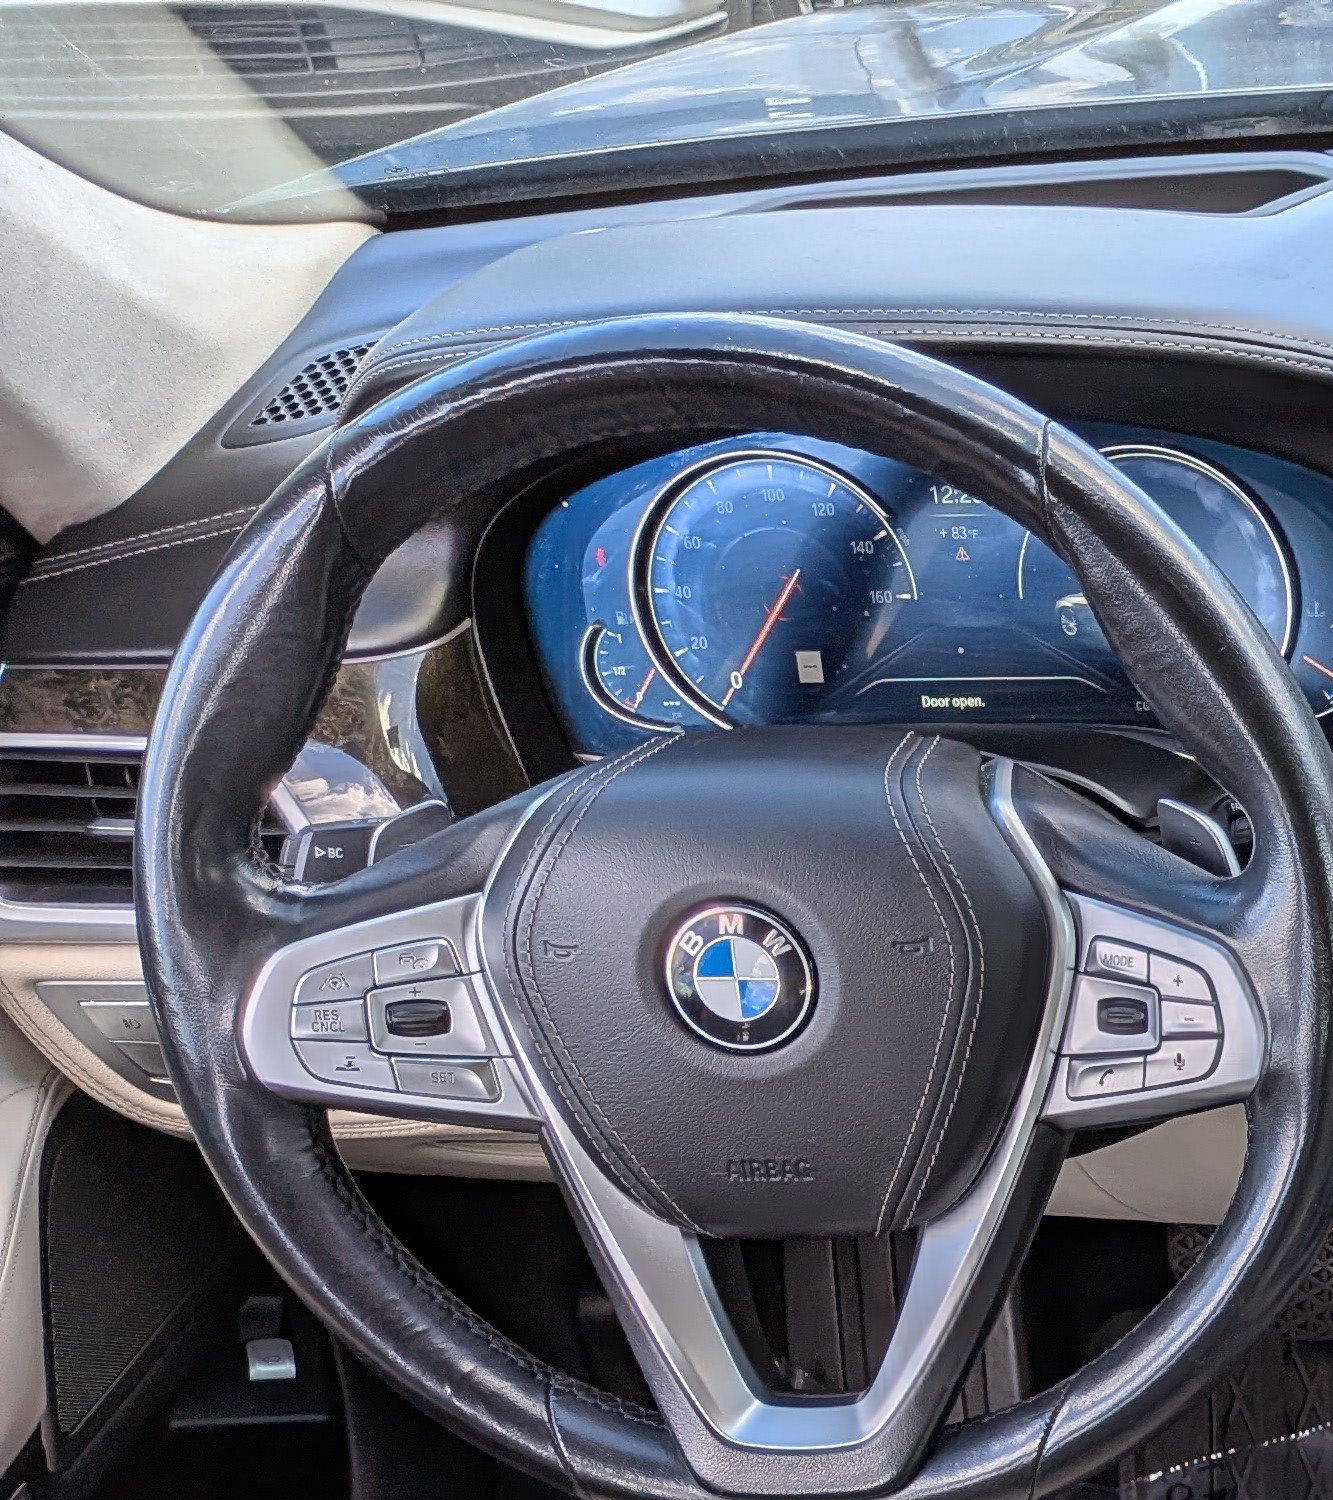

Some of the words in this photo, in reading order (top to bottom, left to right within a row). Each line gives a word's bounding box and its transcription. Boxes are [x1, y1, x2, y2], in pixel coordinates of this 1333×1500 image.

[762, 488, 785, 502] 100
[715, 501, 734, 515] 80
[811, 502, 835, 517] 120
[683, 535, 701, 550] 60
[850, 540, 874, 555] 140
[674, 585, 692, 599] 40
[869, 590, 893, 604] 160
[690, 636, 708, 650] 20
[730, 671, 743, 689] 0
[920, 694, 950, 708] Door
[952, 696, 986, 710] open.
[326, 845, 344, 860] BC
[678, 913, 793, 958] BMW
[1099, 954, 1135, 969] MODE
[314, 1008, 341, 1022] RES
[311, 1020, 347, 1034] CNCL
[430, 1071, 455, 1085] SET
[725, 1157, 814, 1182] AIRBAG
